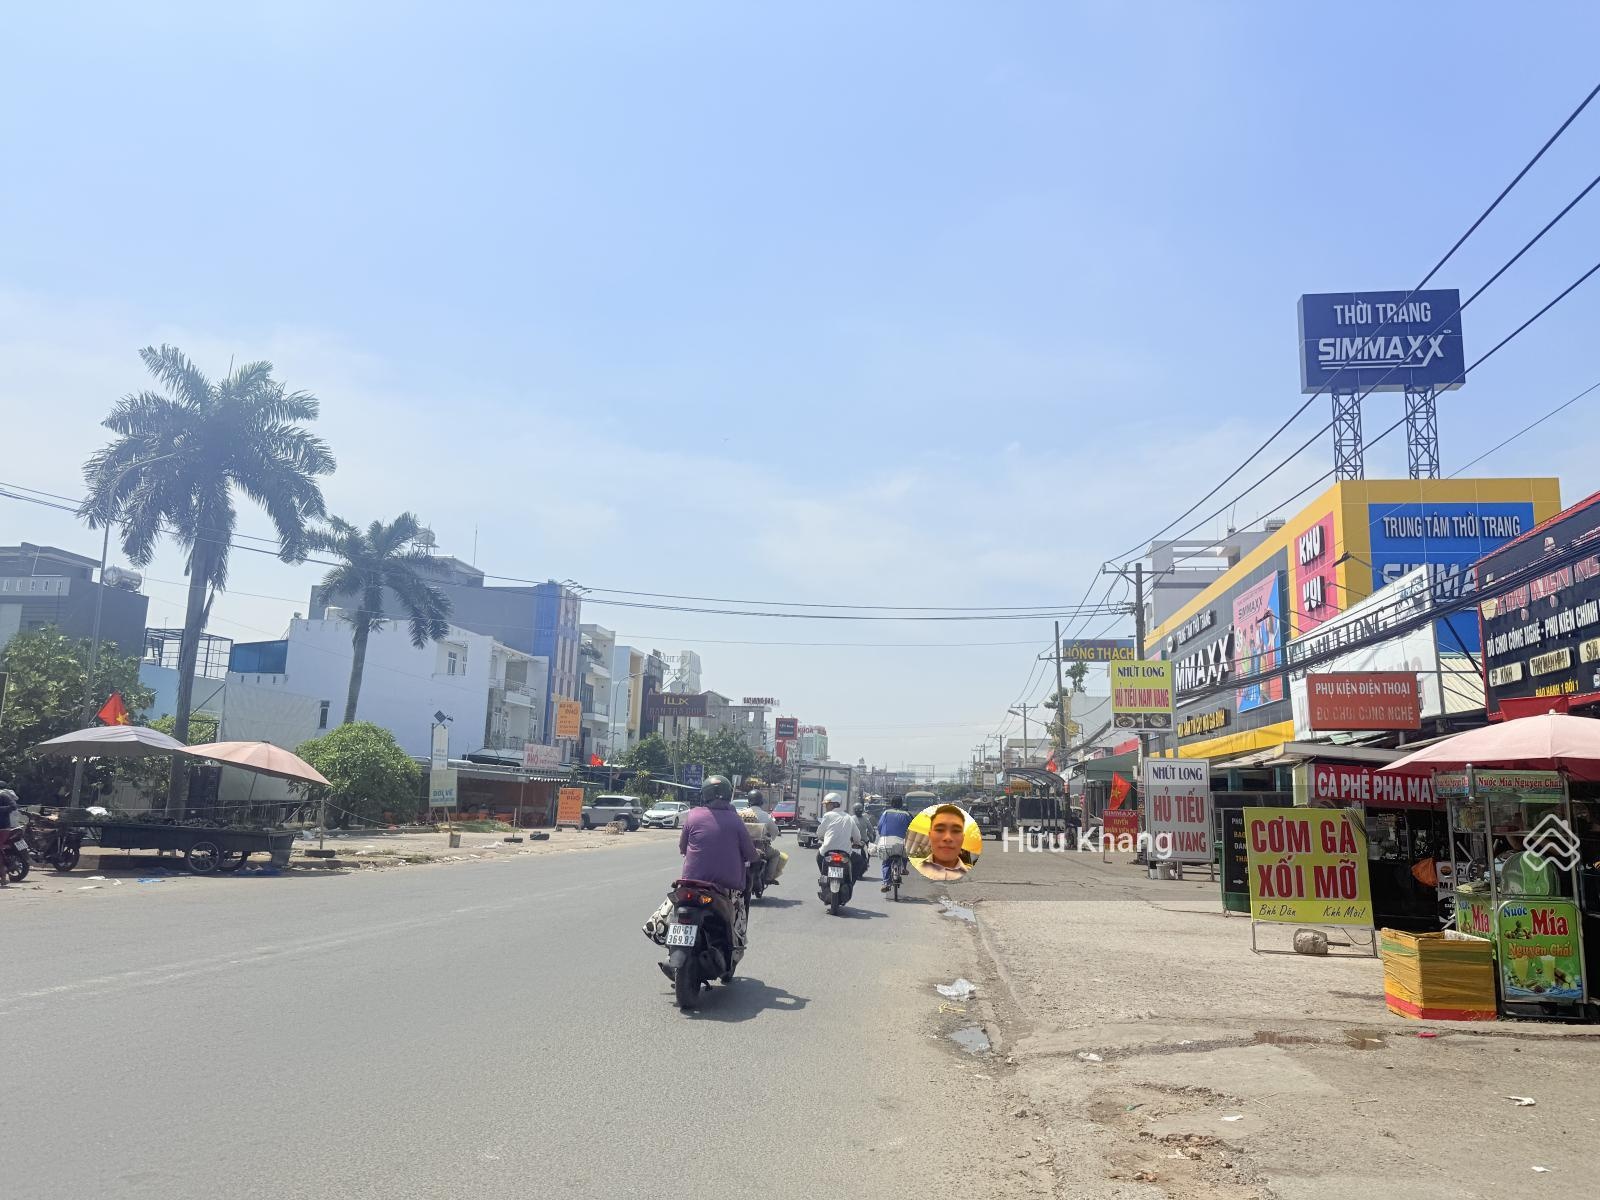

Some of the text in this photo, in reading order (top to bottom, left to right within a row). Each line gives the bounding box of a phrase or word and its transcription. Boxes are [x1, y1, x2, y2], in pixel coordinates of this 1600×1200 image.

[1334, 300, 1432, 325] THỜI TRANG
[1318, 335, 1444, 367] SIMMAXX
[1383, 511, 1521, 537] TRUNG TÂM THỜI TRANG
[1063, 641, 1094, 659] HỒNG
[1142, 667, 1165, 677] LONG
[1153, 689, 1169, 707] VANG
[1315, 679, 1410, 699] PHỤ KIỆN ĐIỆN THOẠI
[1153, 765, 1203, 780] NHỨT LONG
[1318, 767, 1338, 797] CÀ
[1341, 769, 1370, 799] PHÊ
[1373, 775, 1404, 801] PHA
[1153, 785, 1171, 822] HỦ
[1175, 788, 1205, 823] TIẾU
[1178, 831, 1207, 853] VANG
[1251, 814, 1357, 853] CƠM GÀ
[1257, 855, 1305, 898] XỐI
[1314, 859, 1357, 900] MỠ
[1259, 904, 1296, 916] Bình Dân
[1471, 903, 1490, 933] Mía
[1503, 904, 1528, 918] Nước
[1530, 908, 1569, 936] Mía
[1507, 943, 1548, 959] Nguyên
